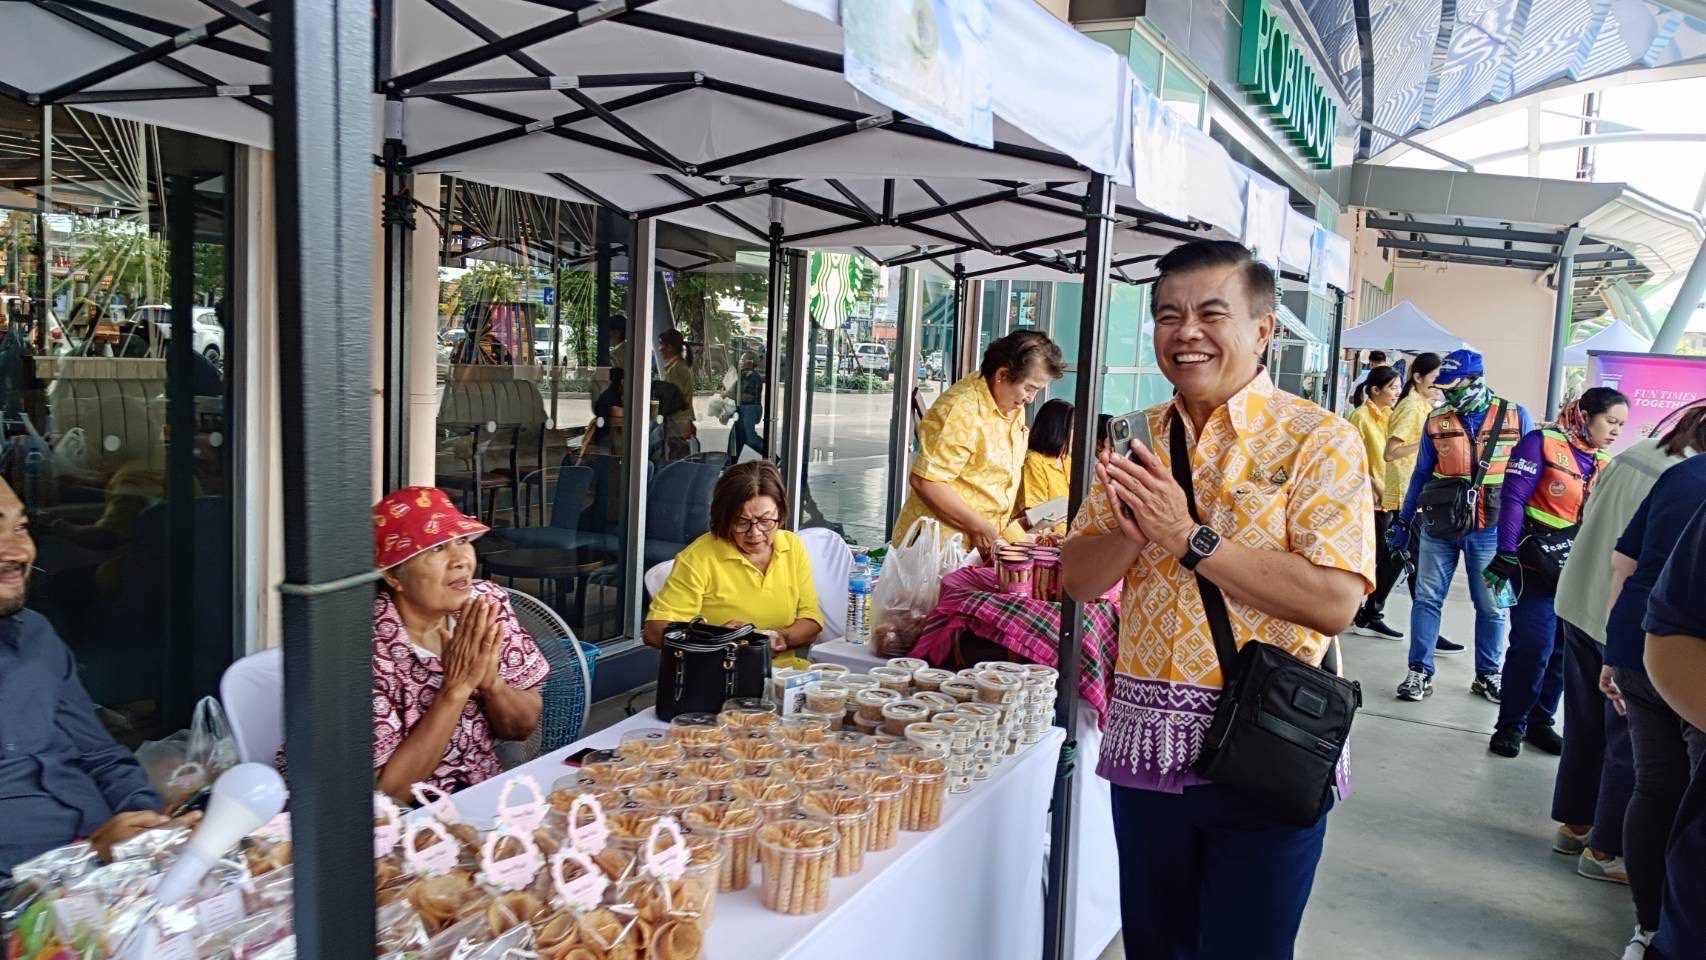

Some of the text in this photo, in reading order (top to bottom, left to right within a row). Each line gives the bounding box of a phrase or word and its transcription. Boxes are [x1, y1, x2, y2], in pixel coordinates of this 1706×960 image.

[1245, 0, 1337, 170] ROBINSON
[1633, 388, 1697, 401] FUN TIMES
[1635, 399, 1688, 410] TOGETHE
